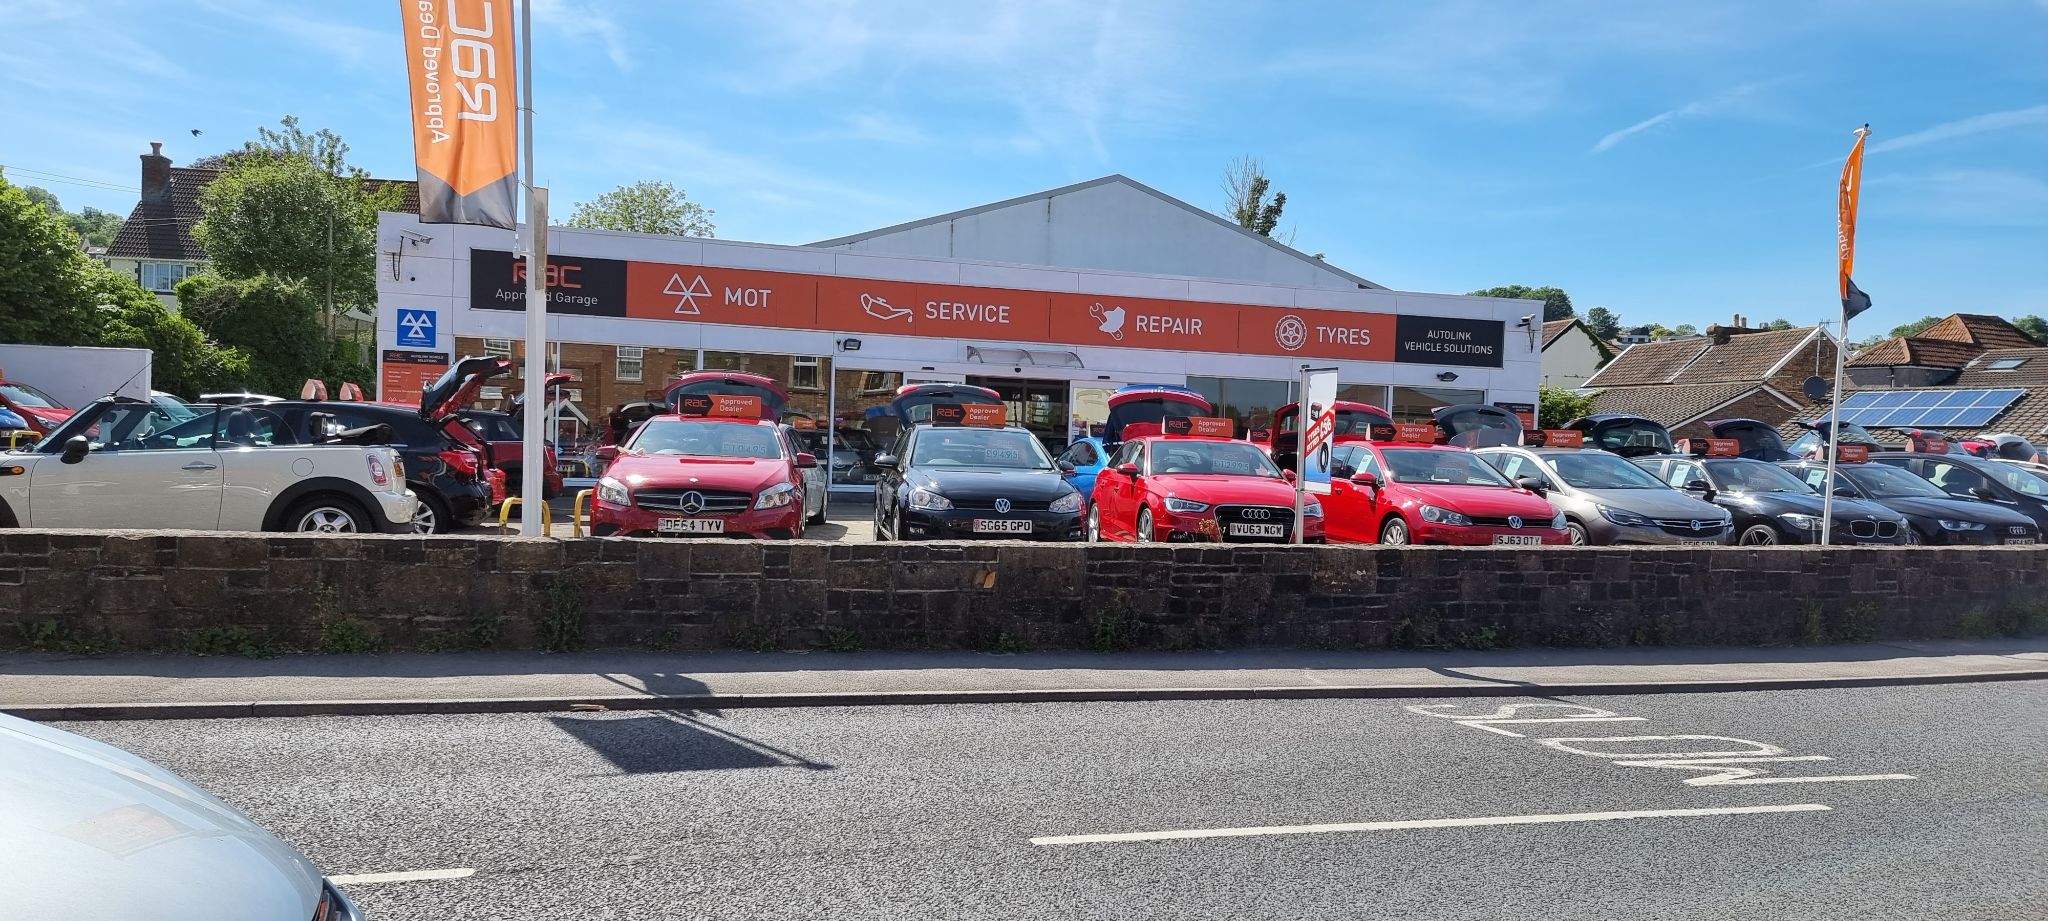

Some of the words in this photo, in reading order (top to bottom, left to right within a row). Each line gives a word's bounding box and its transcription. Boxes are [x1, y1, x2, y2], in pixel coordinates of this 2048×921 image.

[555, 292, 598, 307] Garage
[724, 286, 772, 308] MOT
[925, 301, 1010, 324] SERVICE
[1136, 315, 1203, 336] REPAIR
[1315, 326, 1371, 346] TYRES
[1426, 329, 1472, 341] AUTOLINK
[1404, 341, 1443, 353] VEHICLE
[1443, 343, 1493, 355] SOLUTIONS
[719, 398, 753, 406] Approved
[1198, 419, 1226, 427] Approved
[700, 520, 722, 531] TYV
[980, 520, 1008, 531] SG65
[1010, 521, 1031, 531] GPO
[1237, 524, 1262, 535] VU63
[1498, 535, 1522, 545] SJ63
[1404, 702, 1918, 787] SLOW
